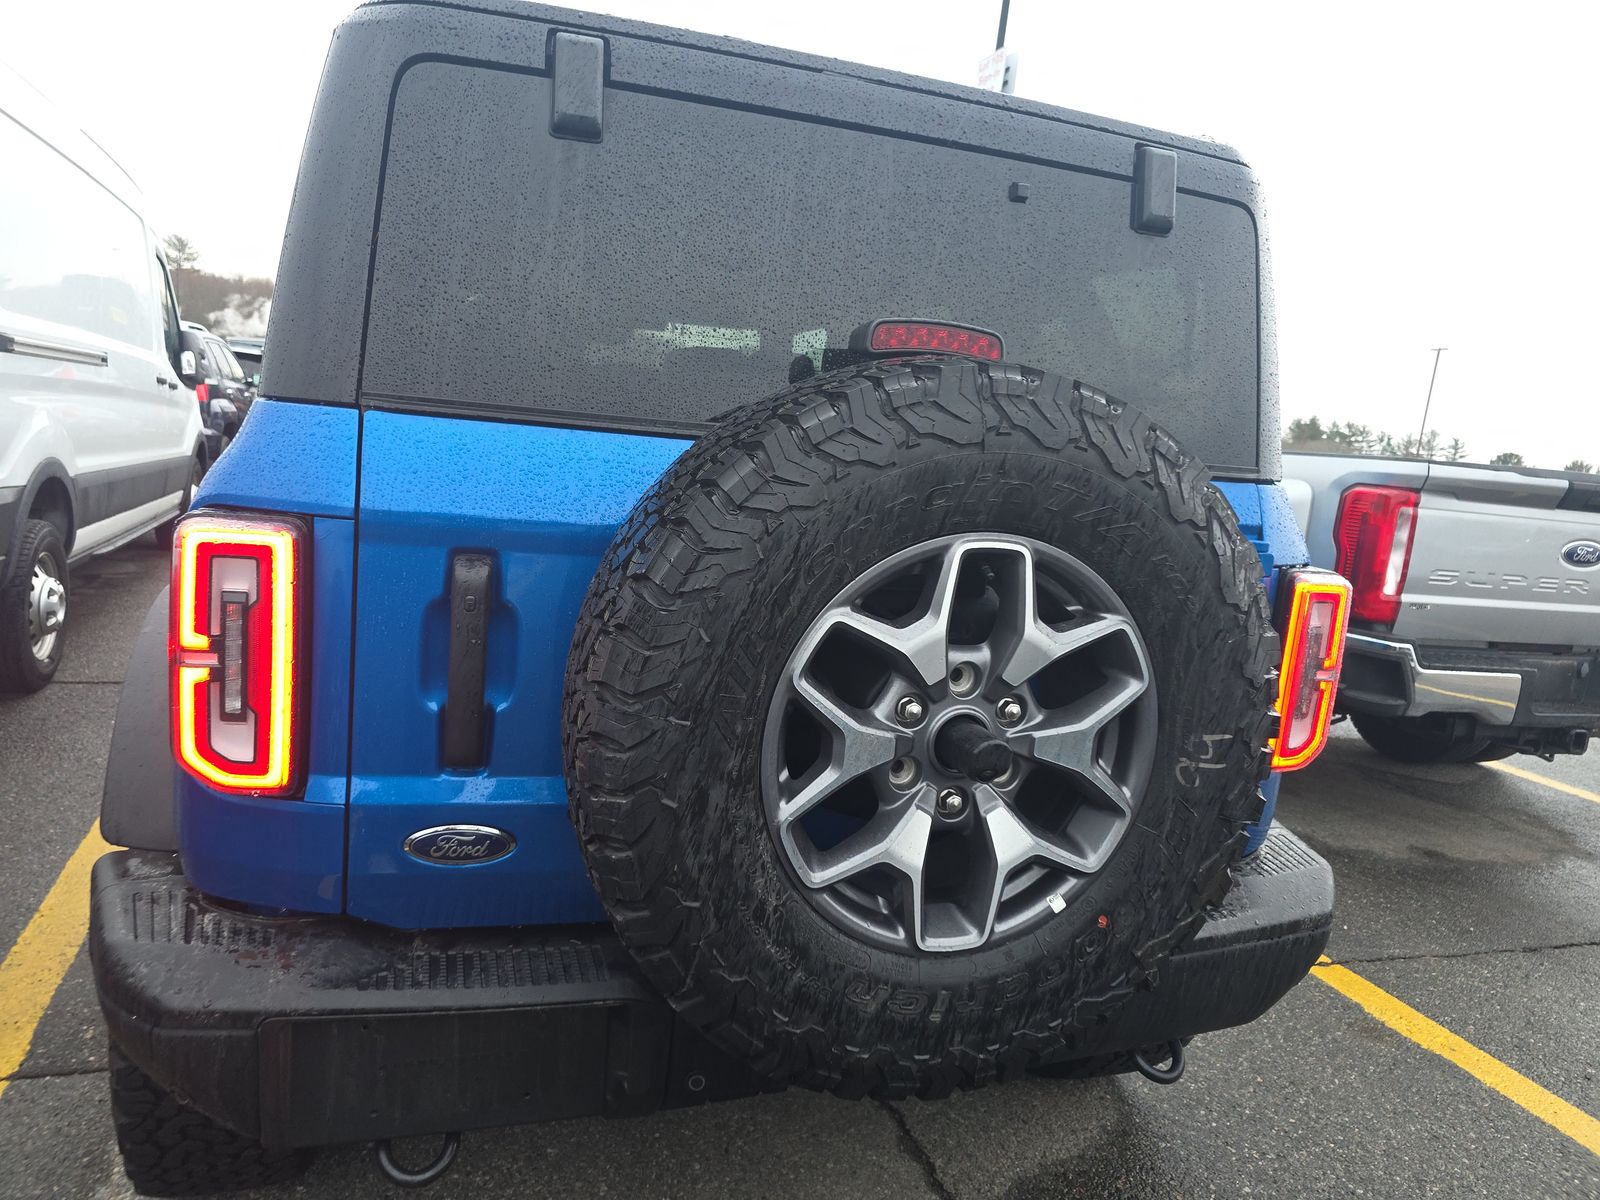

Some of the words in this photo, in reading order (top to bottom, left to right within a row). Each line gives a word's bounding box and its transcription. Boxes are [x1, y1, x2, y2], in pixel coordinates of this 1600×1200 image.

[1573, 545, 1600, 562] Ford
[1428, 568, 1590, 595] SUPER
[430, 834, 491, 857] Ford
